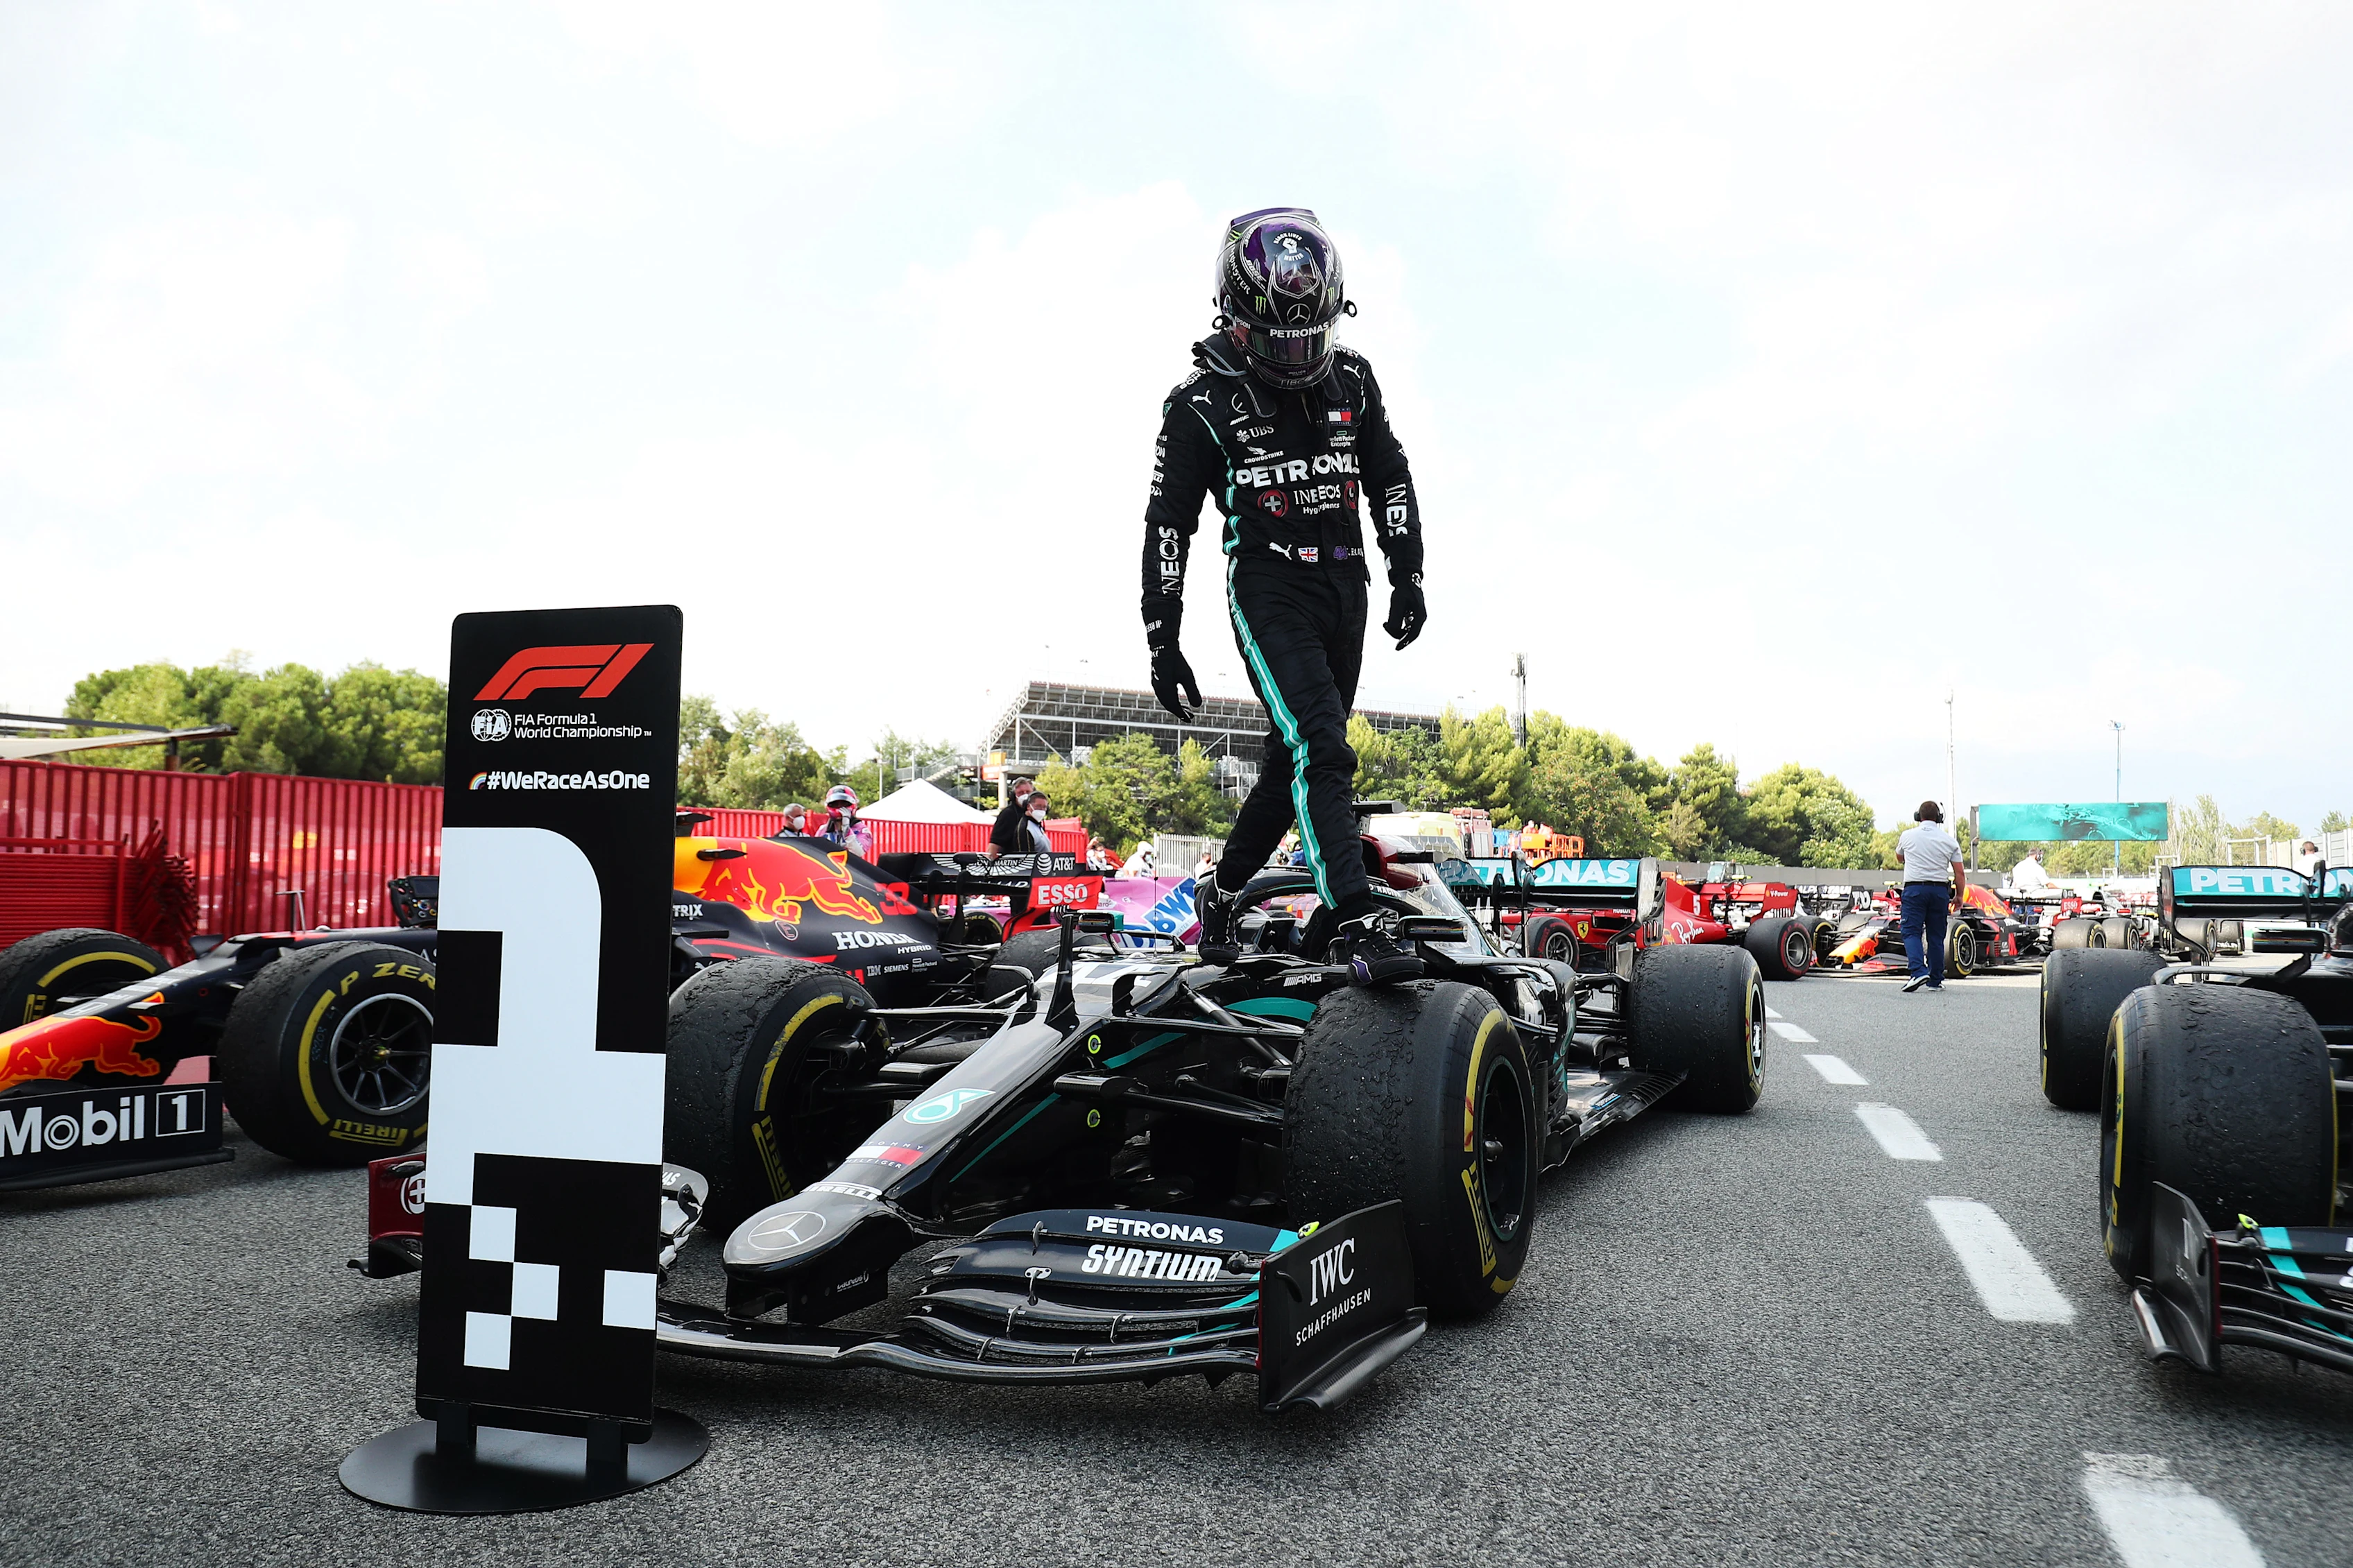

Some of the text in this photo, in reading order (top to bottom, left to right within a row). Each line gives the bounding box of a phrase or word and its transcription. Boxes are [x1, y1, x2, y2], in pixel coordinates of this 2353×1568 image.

[1284, 252, 1304, 261] MATTER
[1269, 321, 1329, 338] PETRONAS
[1249, 424, 1274, 438] UBS
[1244, 451, 1284, 463] CROWDSTRIKE
[515, 714, 597, 725] FIA Formula 1
[514, 725, 551, 739] World
[554, 725, 642, 739] Championship
[487, 770, 650, 790] #WeRaceAsOne
[1053, 857, 1075, 871] AT&T
[1468, 859, 1630, 885] TRONAS
[1038, 884, 1088, 905] ESSO
[1770, 889, 1789, 898] V-Power
[672, 904, 703, 921] TRIX
[1693, 894, 1701, 916] 5
[831, 931, 923, 950] HONDA
[897, 945, 932, 954] HYBRID
[340, 961, 436, 996] P ZER
[866, 963, 909, 977] IBM SIEMENS
[1296, 973, 1322, 984] AMG
[0, 1094, 188, 1157] Mobil 1
[328, 1118, 409, 1147] PIRELLI
[867, 1140, 924, 1151] TOMMY
[846, 1158, 902, 1169] HILFIGER
[800, 1181, 883, 1201] PIRELLI
[1086, 1215, 1224, 1245] PETRONAS
[1310, 1237, 1355, 1307] IWC
[1296, 1287, 1371, 1347] SCHAFFHAUSEN
